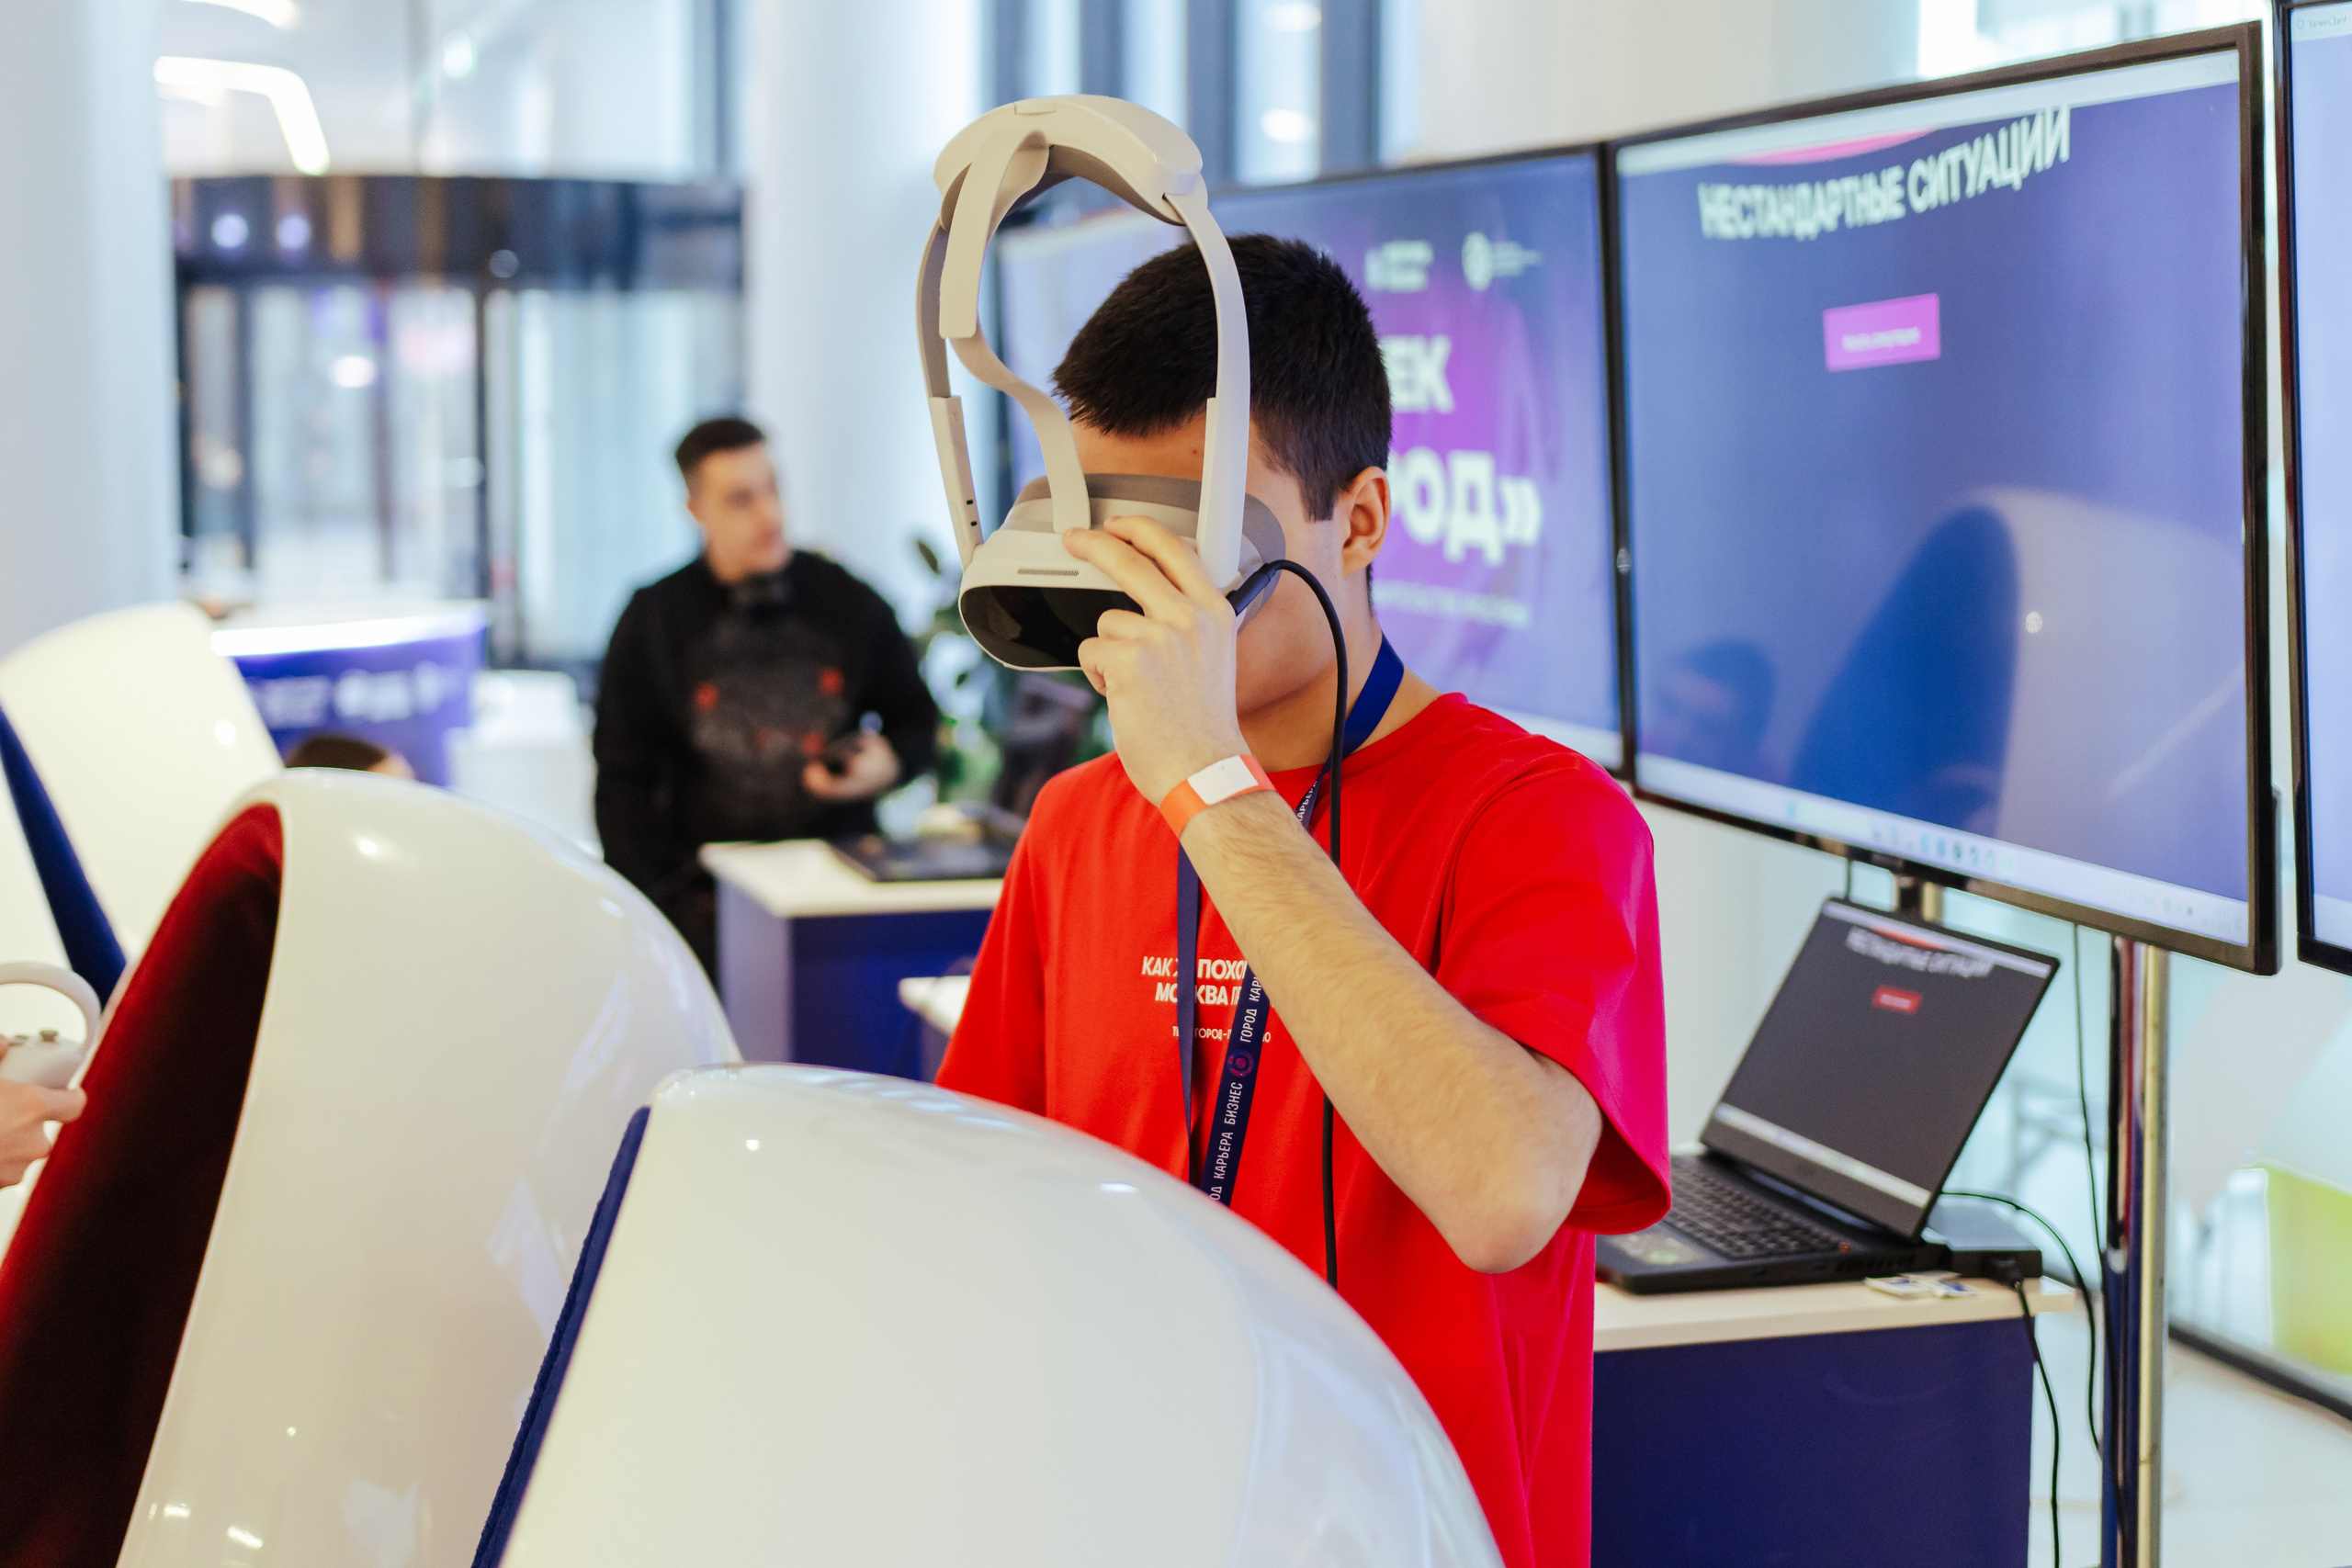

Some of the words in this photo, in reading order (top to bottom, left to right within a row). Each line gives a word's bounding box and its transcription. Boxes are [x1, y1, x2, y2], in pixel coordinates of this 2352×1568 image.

[1698, 165, 1905, 241] НЕСТАНДАРТНЫЕ
[1907, 103, 2071, 213] СИТУАЦИИ
[1378, 333, 1455, 414] ЕК
[1389, 446, 1544, 567] ОД»
[1141, 956, 1173, 976] КАК
[1197, 959, 1248, 979] ПОХО
[1155, 982, 1229, 1006] МОКВА
[1214, 1132, 1234, 1179] КАРЬЕРА
[1224, 1082, 1243, 1125] БИЗНЕС
[1240, 1009, 1258, 1043] ГОРОД
[1249, 976, 1262, 1002] КАР
